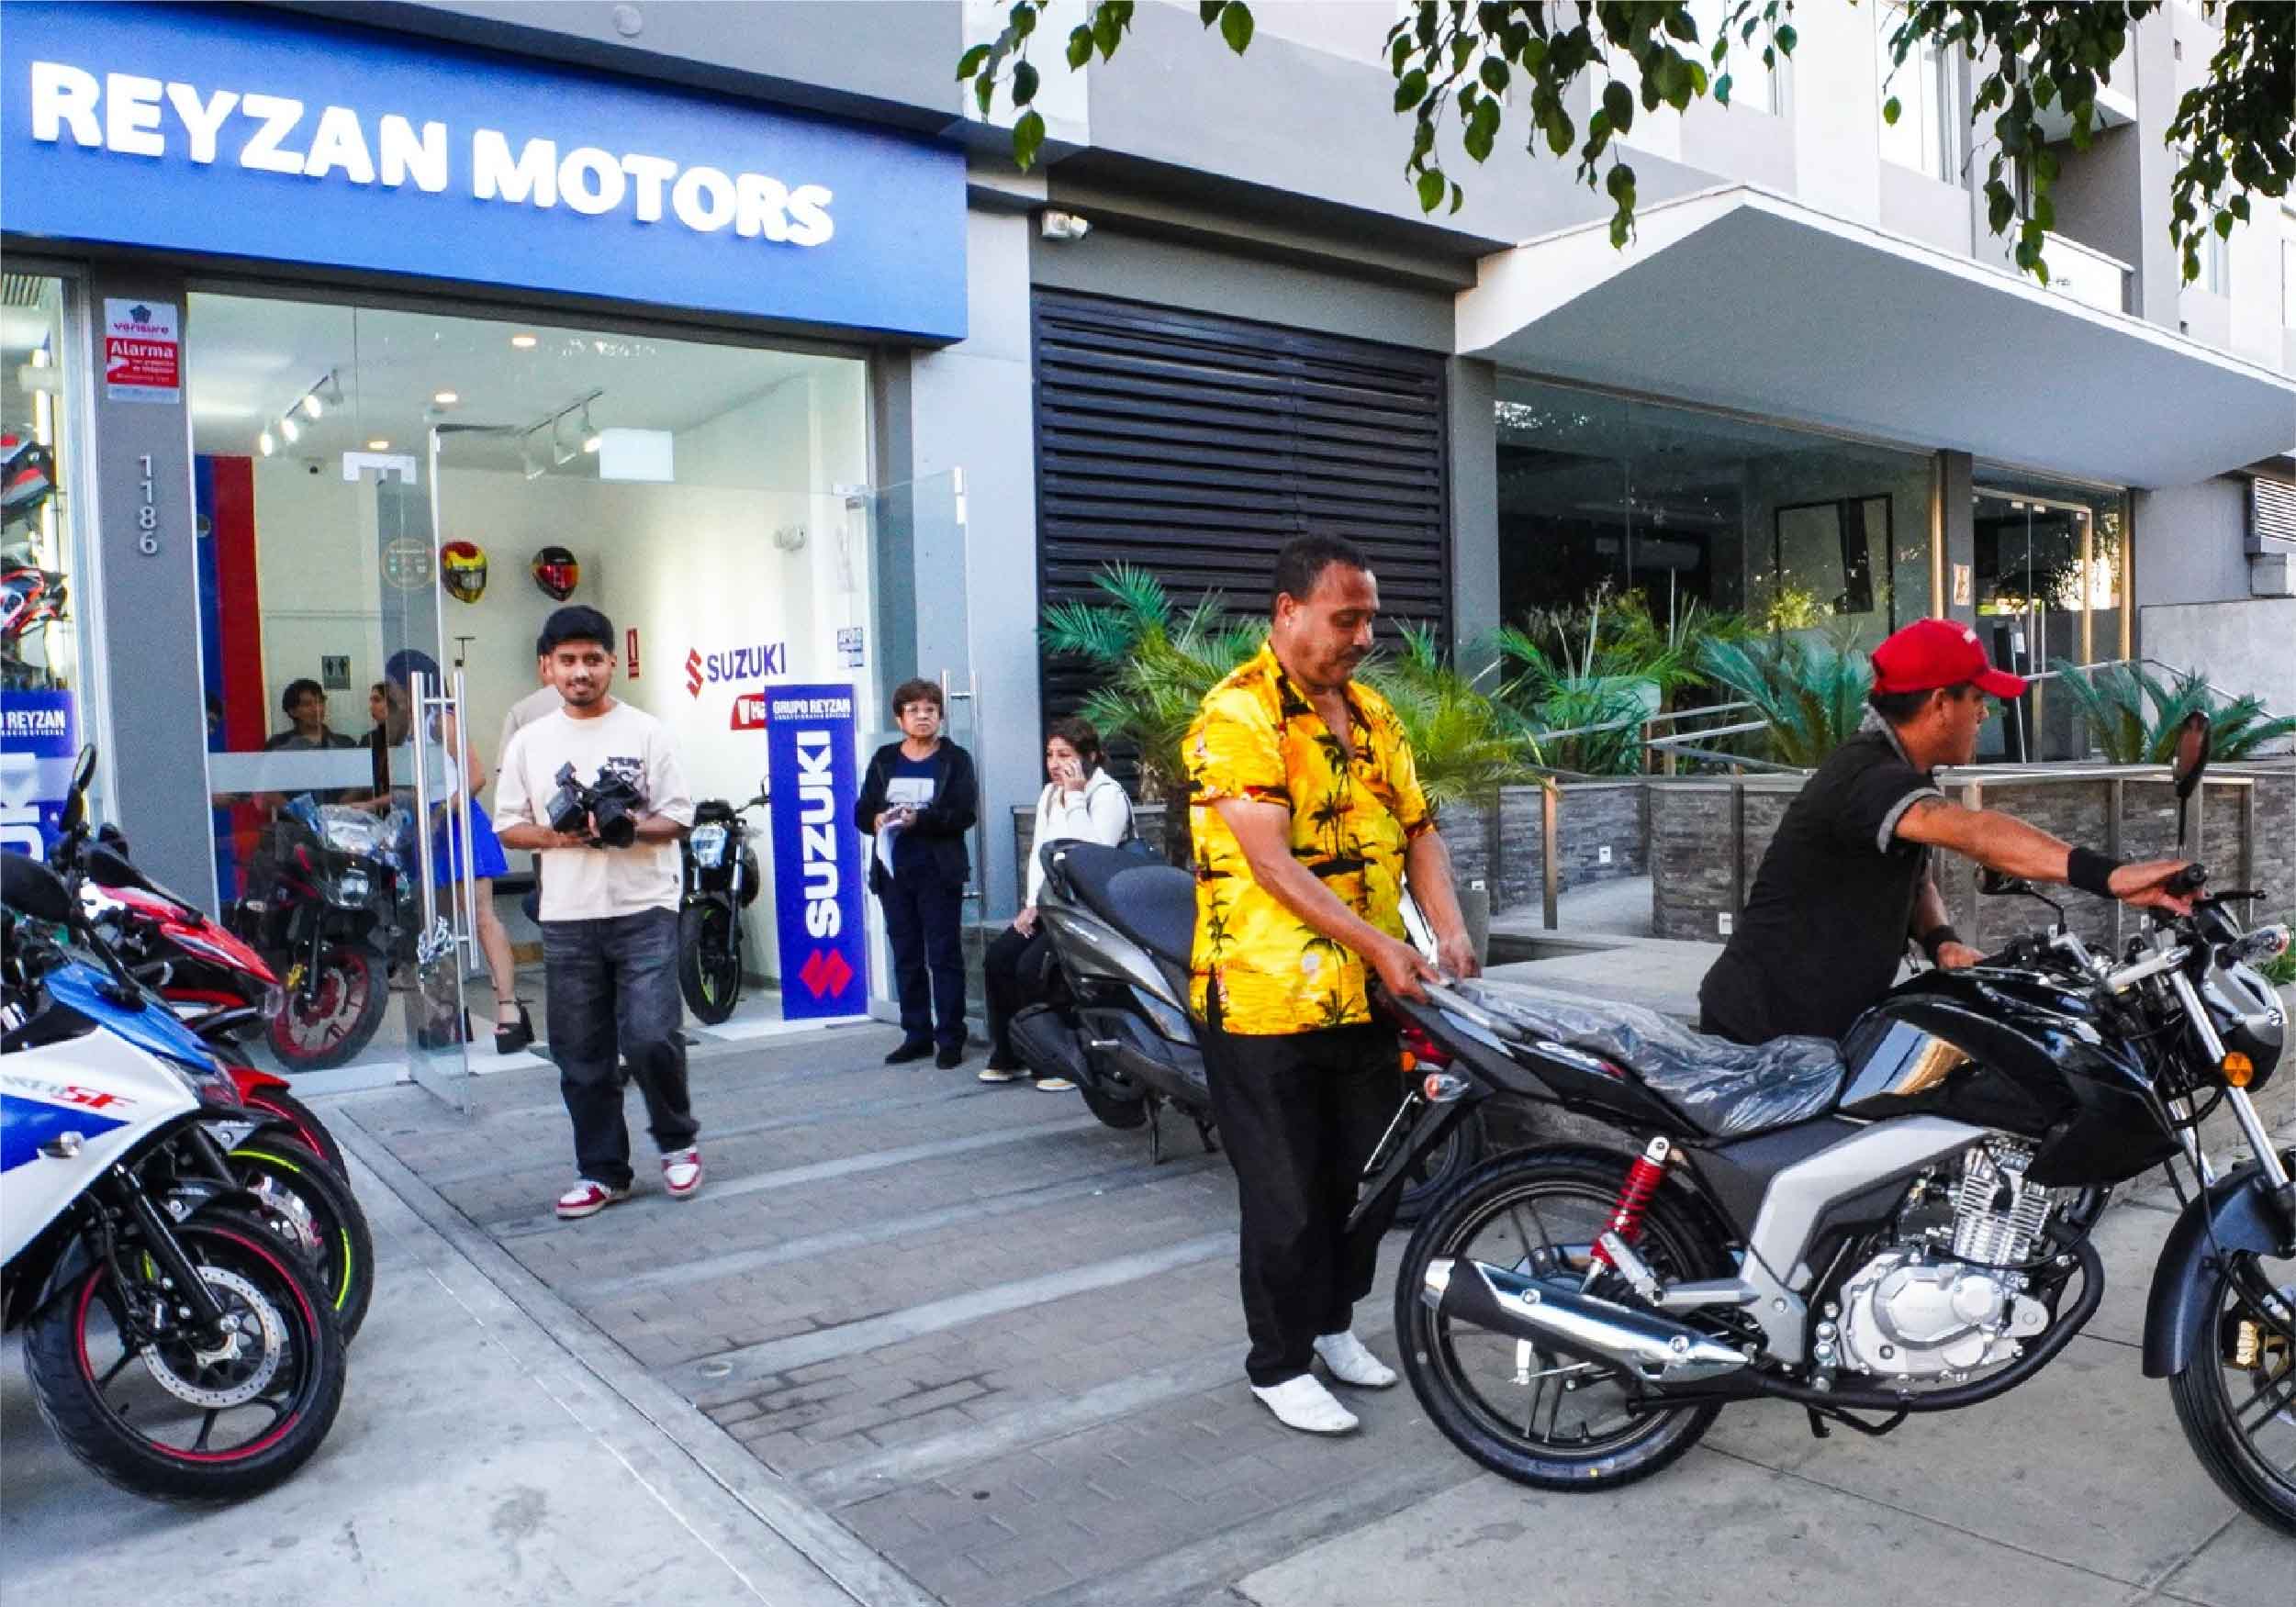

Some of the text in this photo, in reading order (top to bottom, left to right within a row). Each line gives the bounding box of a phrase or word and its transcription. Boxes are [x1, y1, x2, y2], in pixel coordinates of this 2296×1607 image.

[30, 61, 834, 248] REYZAN MOTORS
[111, 340, 174, 359] Alarma
[139, 454, 159, 555] 1186
[707, 642, 787, 683] SUZUKI
[7, 709, 66, 729] REYZAN
[772, 699, 807, 714] GRUPO
[796, 730, 840, 939] SUZUKI
